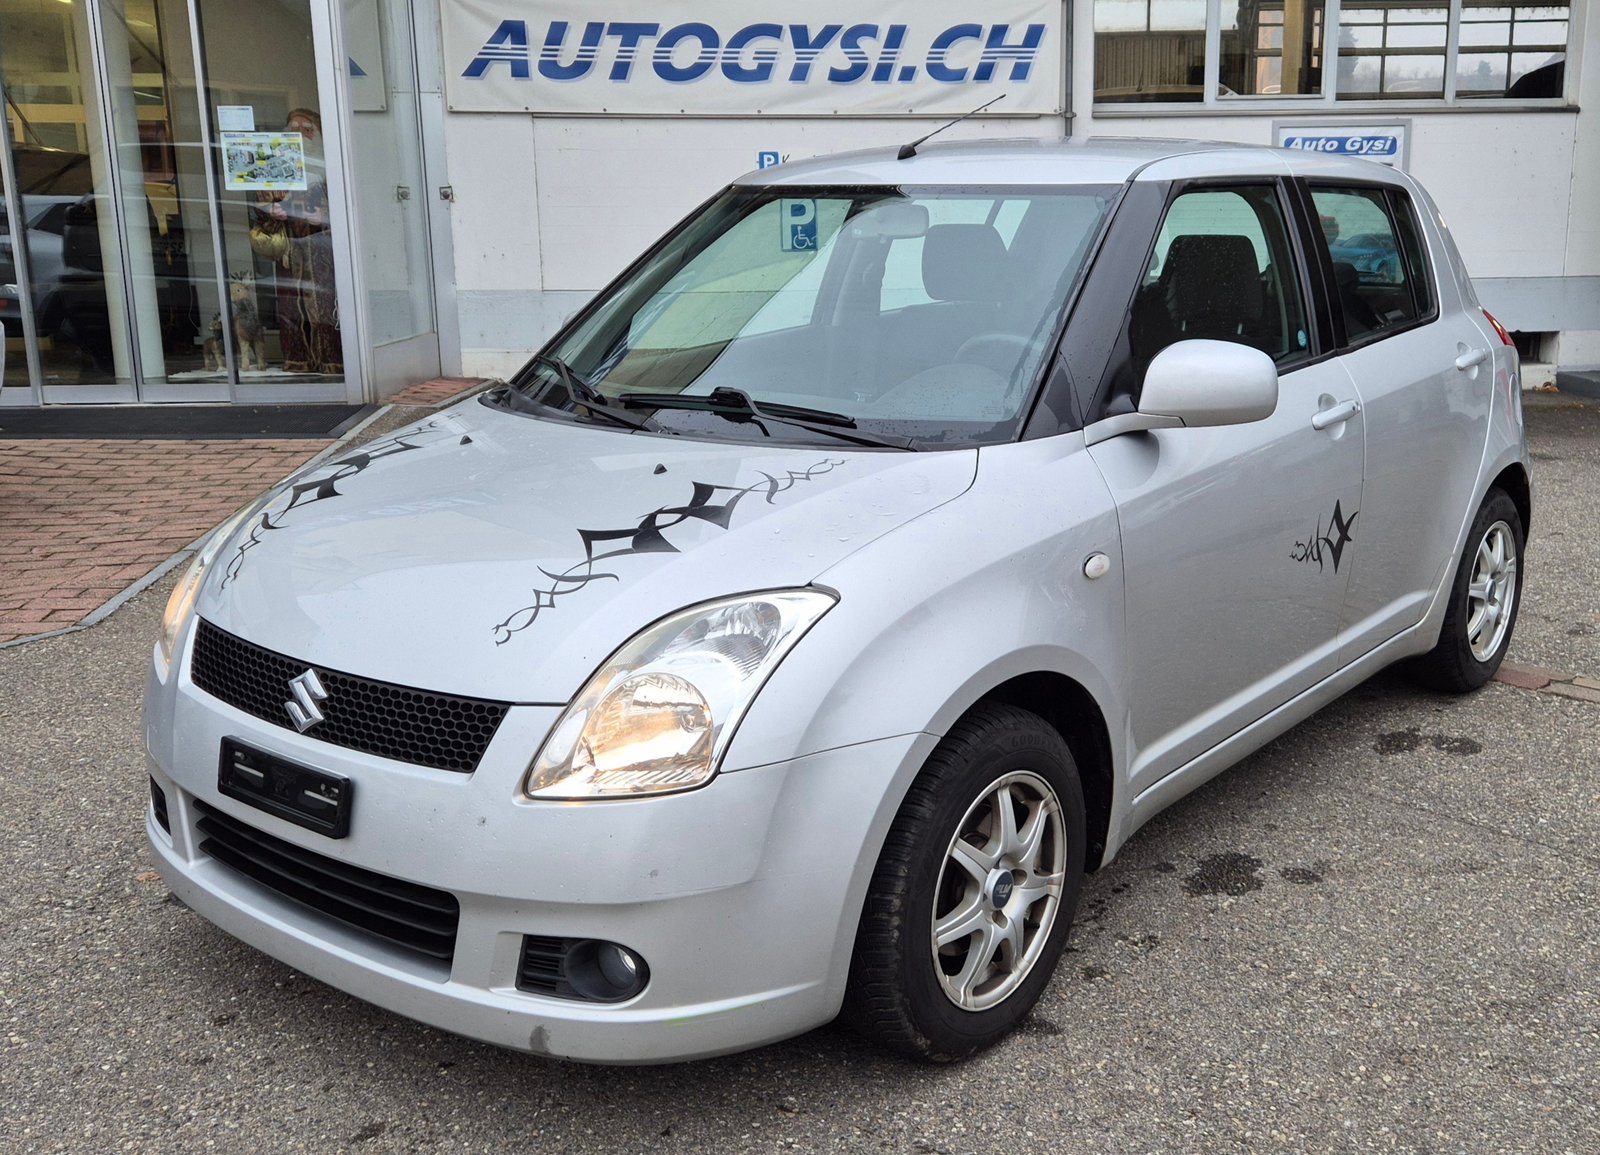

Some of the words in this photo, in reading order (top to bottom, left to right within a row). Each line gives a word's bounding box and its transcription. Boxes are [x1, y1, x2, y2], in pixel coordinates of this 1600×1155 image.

[462, 19, 1048, 83] AUTOGYSI.CH
[763, 154, 775, 169] P
[1289, 137, 1339, 151] Auto
[1345, 136, 1394, 154] Gysi
[782, 198, 815, 249] P
